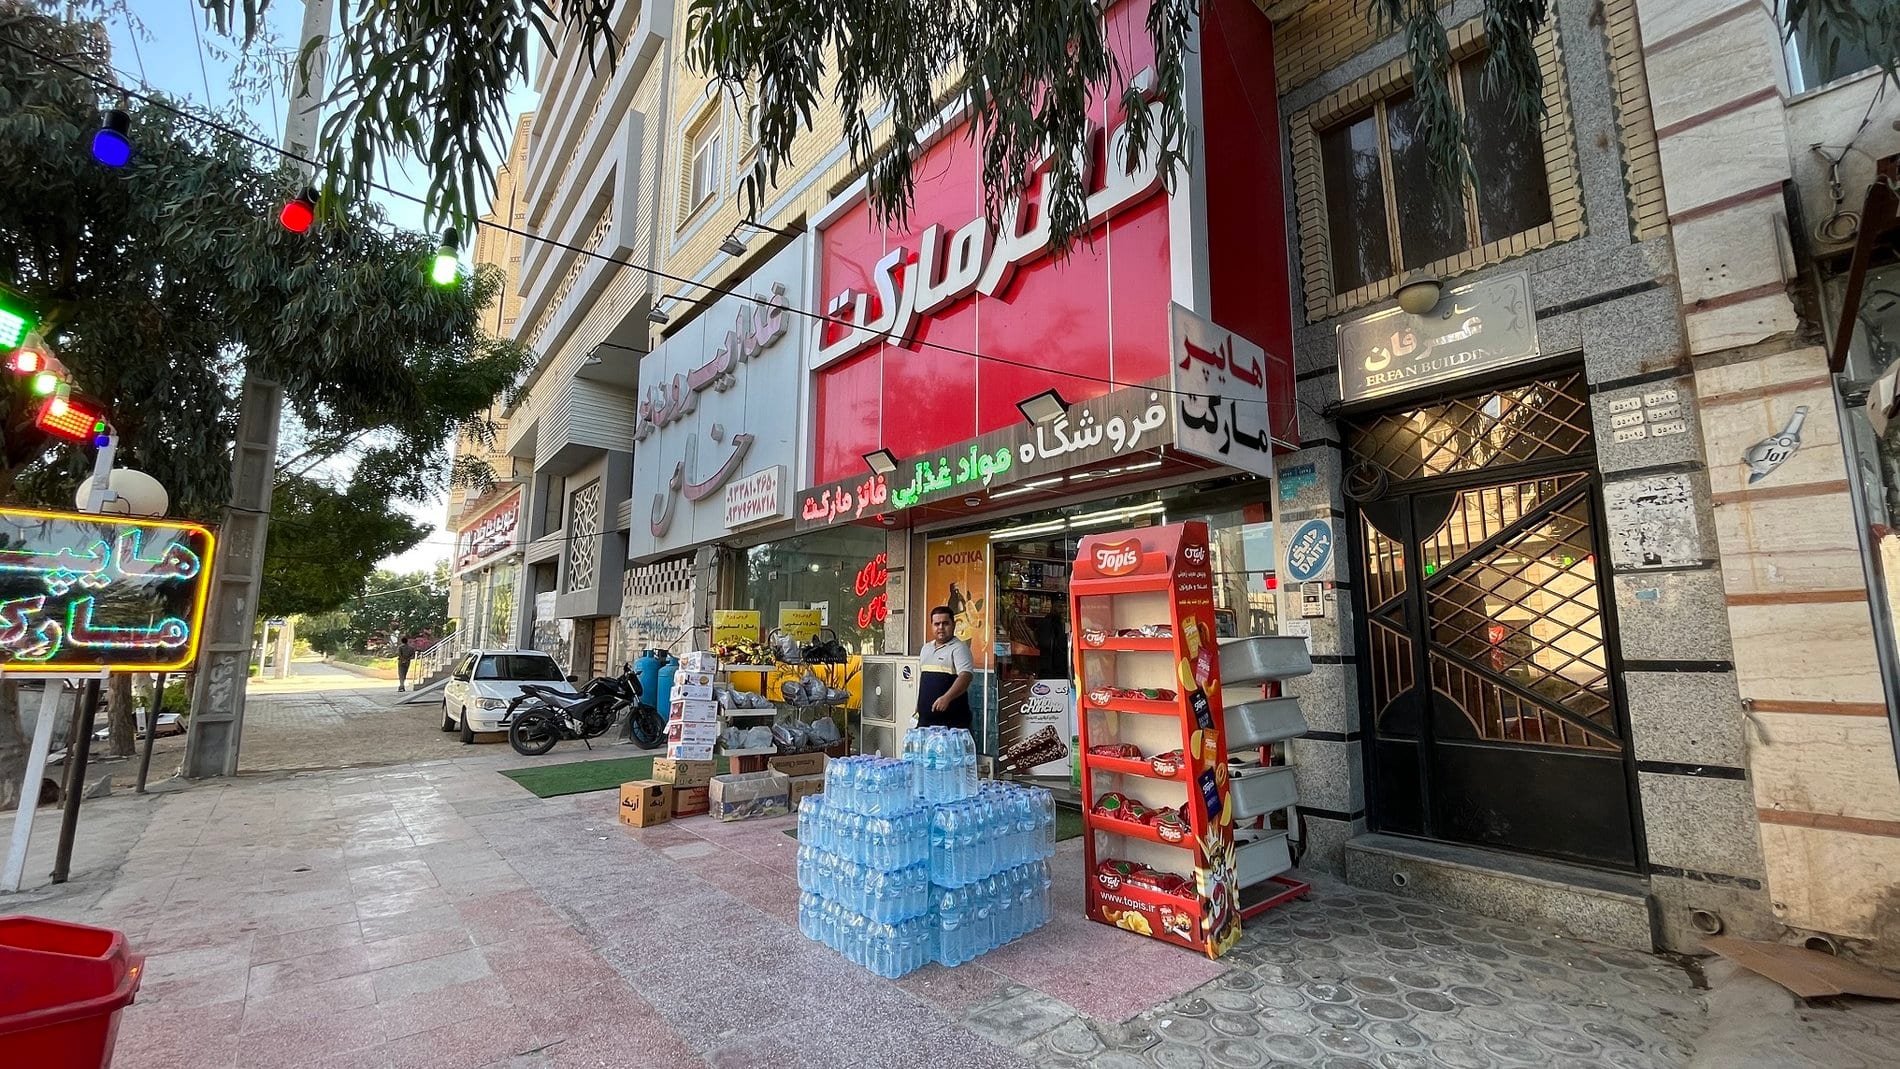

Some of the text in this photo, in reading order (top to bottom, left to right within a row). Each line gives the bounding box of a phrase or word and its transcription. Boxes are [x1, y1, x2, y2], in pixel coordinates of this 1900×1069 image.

[1179, 335, 1263, 391] هایپر
[1366, 361, 1417, 387] ERFAN
[1019, 392, 1168, 464] فروشگاه
[1181, 394, 1268, 455] مارکت
[892, 457, 952, 510] غذایی
[957, 445, 1012, 487] مواد
[802, 485, 852, 524] مارکت
[1097, 547, 1137, 571] Topis
[1299, 534, 1330, 575] DAITY
[0, 594, 189, 661] مارک
[1153, 761, 1176, 774] Topis
[1159, 827, 1182, 840] Topis
[1100, 891, 1157, 914] www.topis.ir
